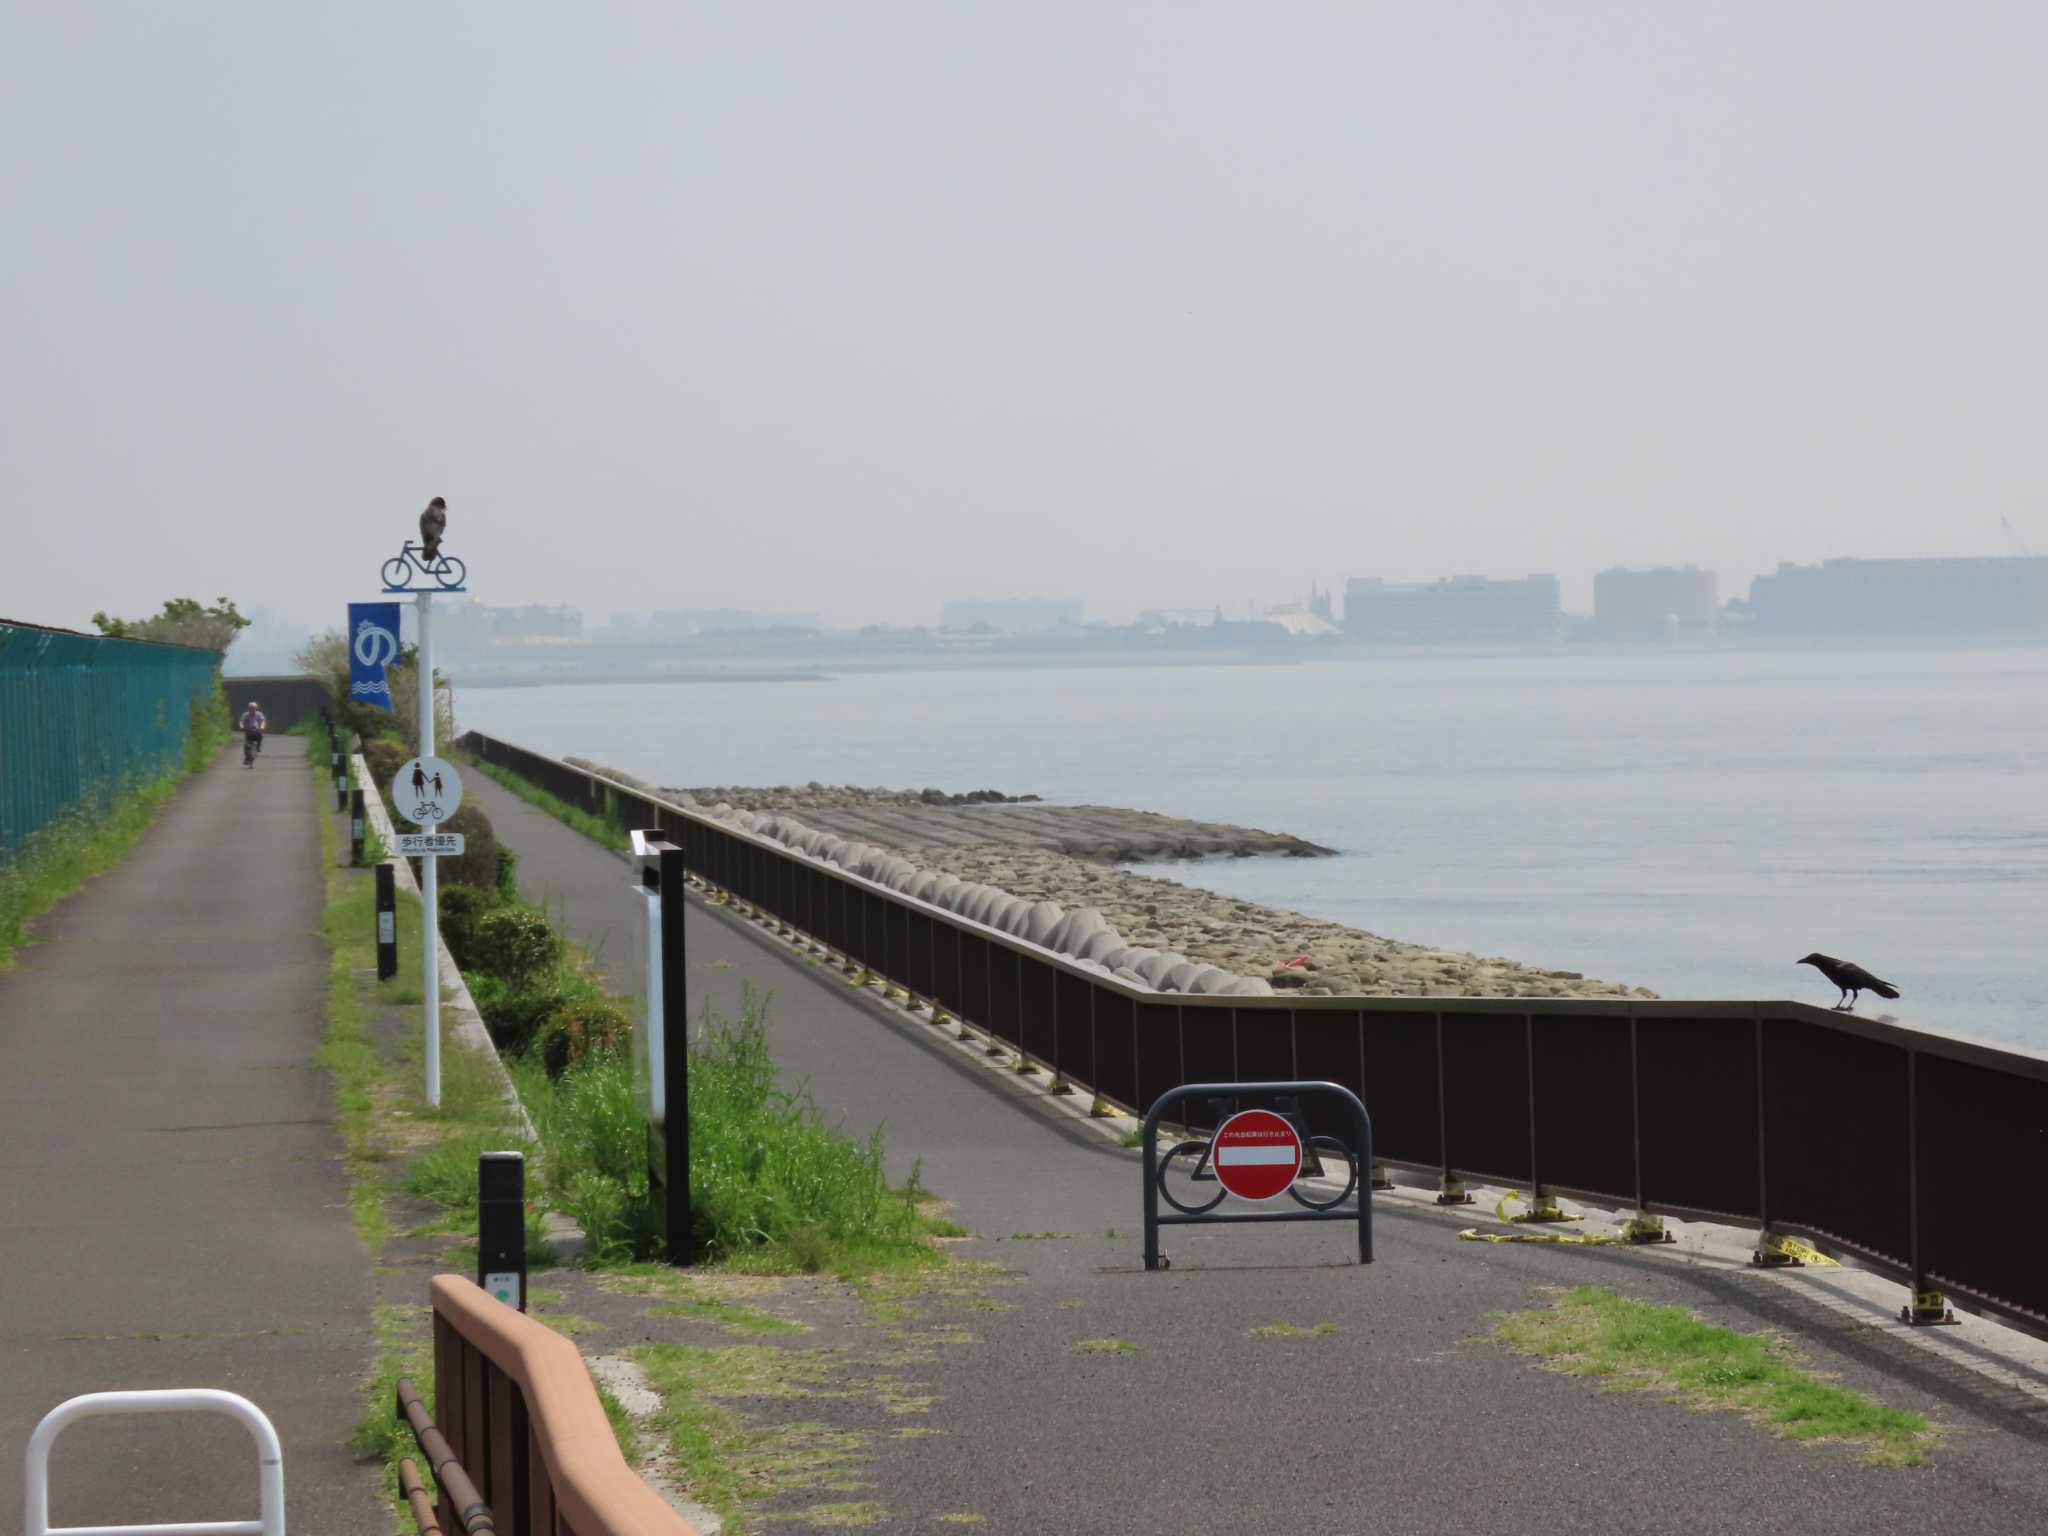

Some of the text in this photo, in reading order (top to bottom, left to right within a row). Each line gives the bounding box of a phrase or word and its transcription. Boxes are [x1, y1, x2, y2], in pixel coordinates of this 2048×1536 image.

[401, 836, 457, 848] 歩行者優先
